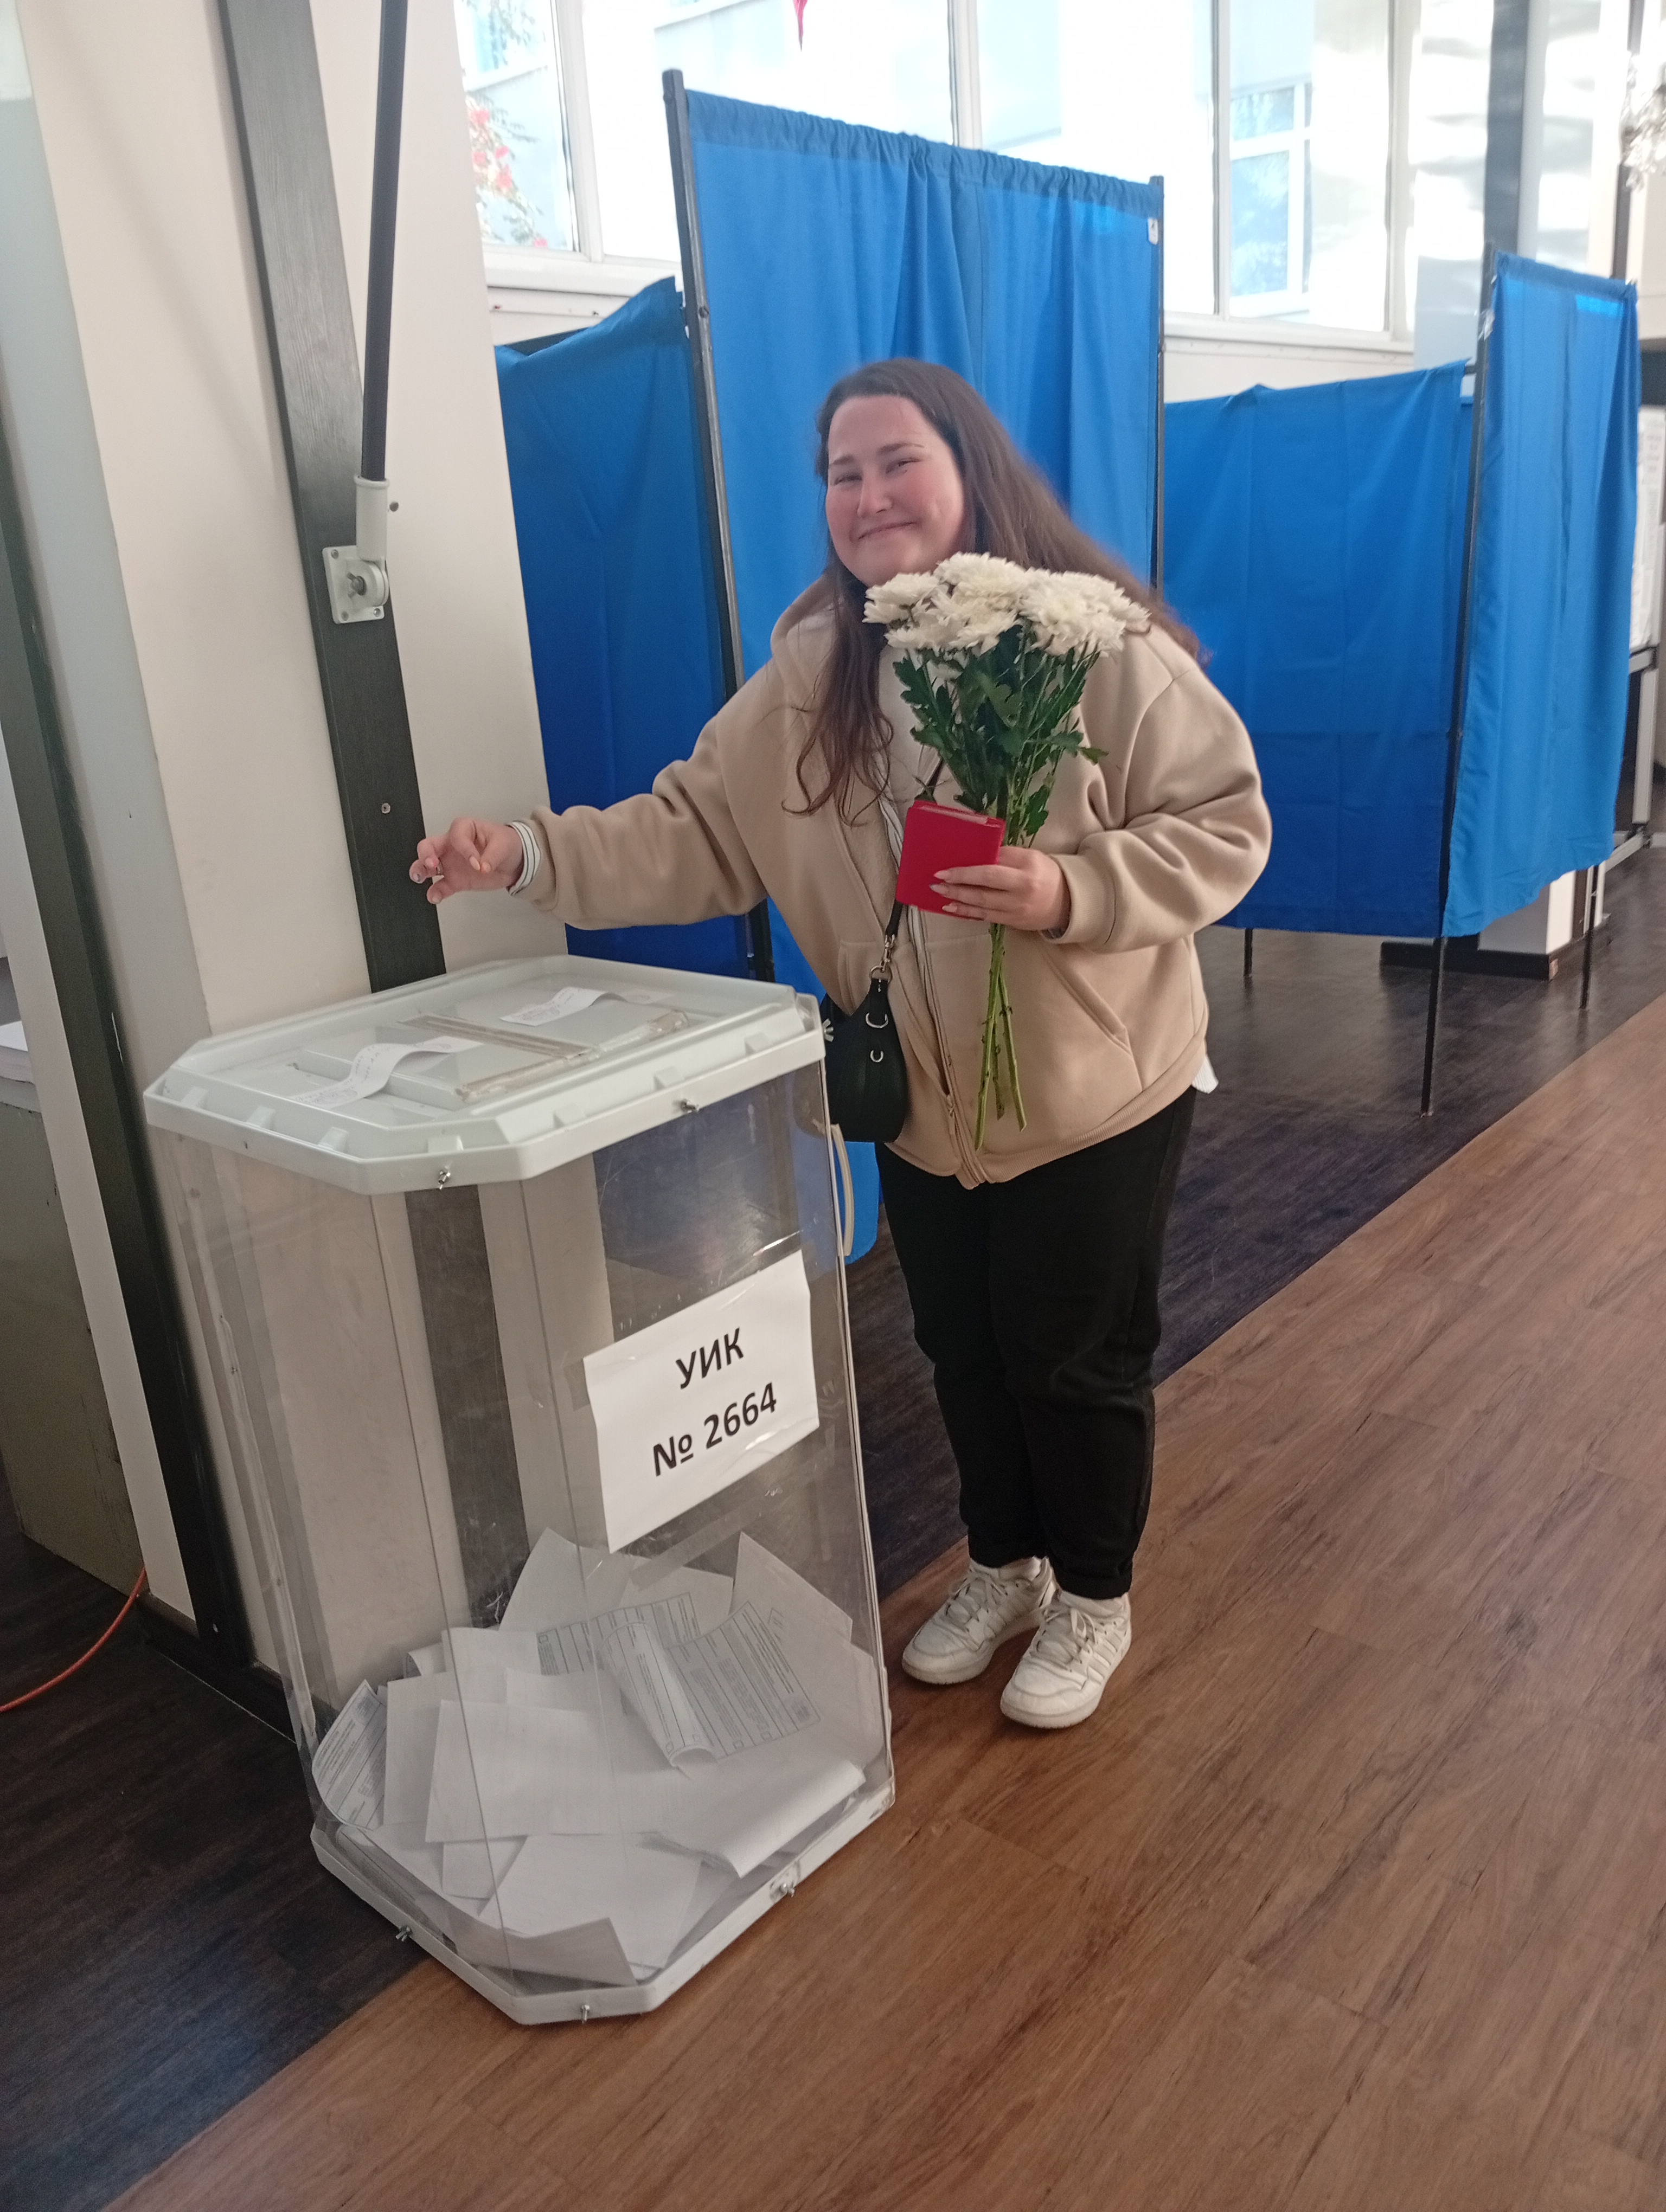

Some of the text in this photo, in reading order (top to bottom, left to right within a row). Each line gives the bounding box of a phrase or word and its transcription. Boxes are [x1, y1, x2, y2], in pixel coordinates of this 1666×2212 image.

[675, 1327, 744, 1390] УИК
[652, 1382, 777, 1477] № 2664
